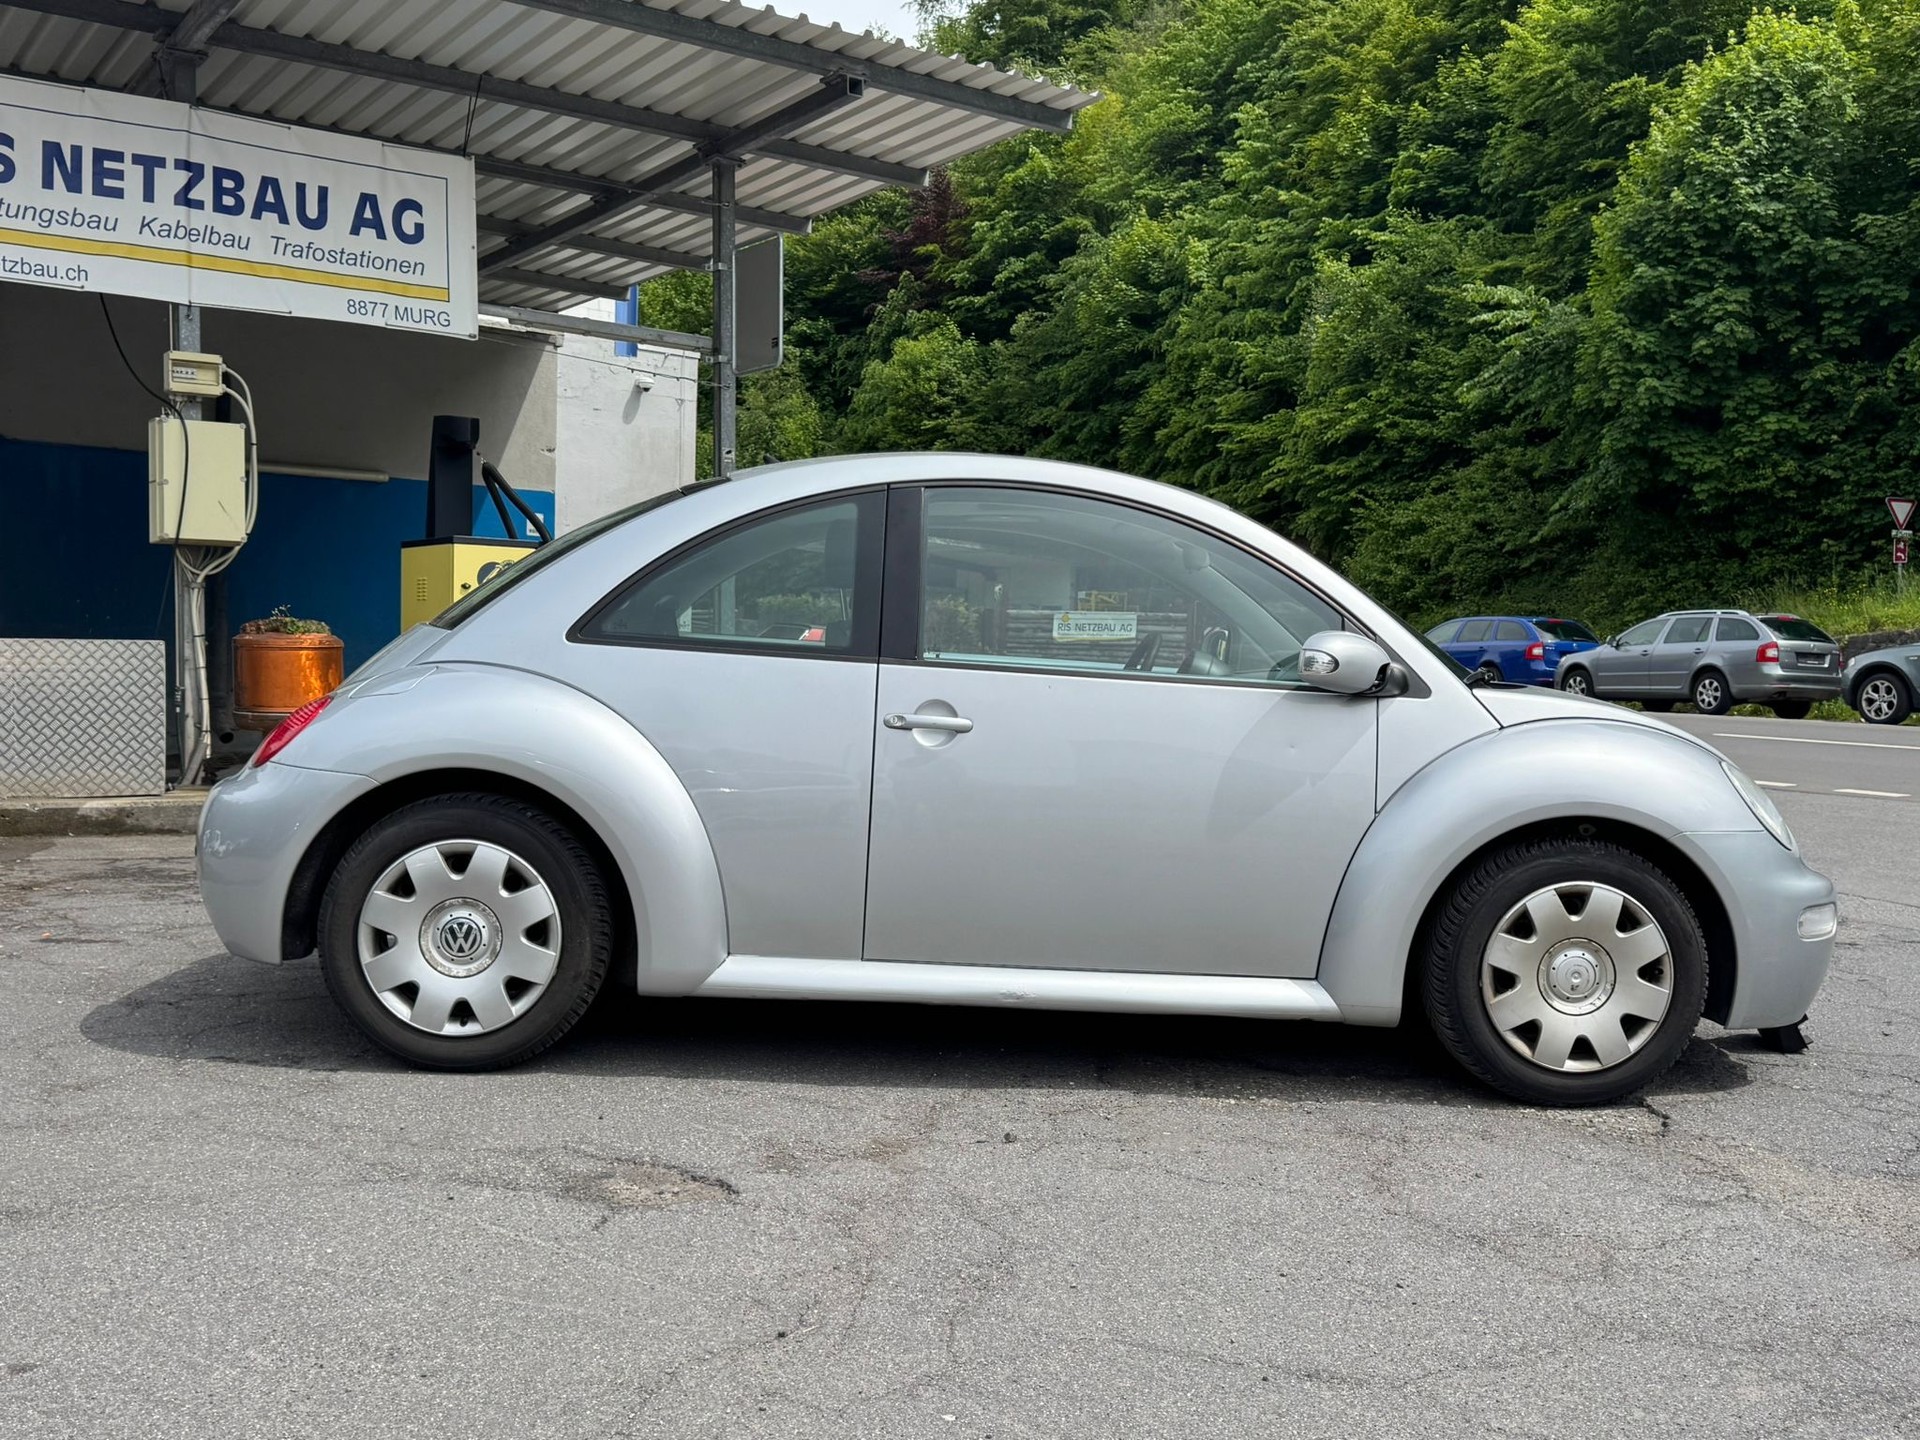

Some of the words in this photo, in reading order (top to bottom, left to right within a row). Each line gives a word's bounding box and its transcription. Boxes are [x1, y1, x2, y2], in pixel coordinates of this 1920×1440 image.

[41, 139, 329, 231] NETZBAU
[349, 191, 425, 245] AG
[138, 215, 252, 251] Kabelbau
[270, 235, 426, 277] Trafostationen
[1, 255, 89, 282] tzbau.ch
[346, 298, 389, 318] 8877
[394, 305, 451, 328] MURG
[1057, 622, 1072, 632] RIS
[1074, 622, 1116, 632] NETZBAU
[1119, 623, 1133, 633] AG
